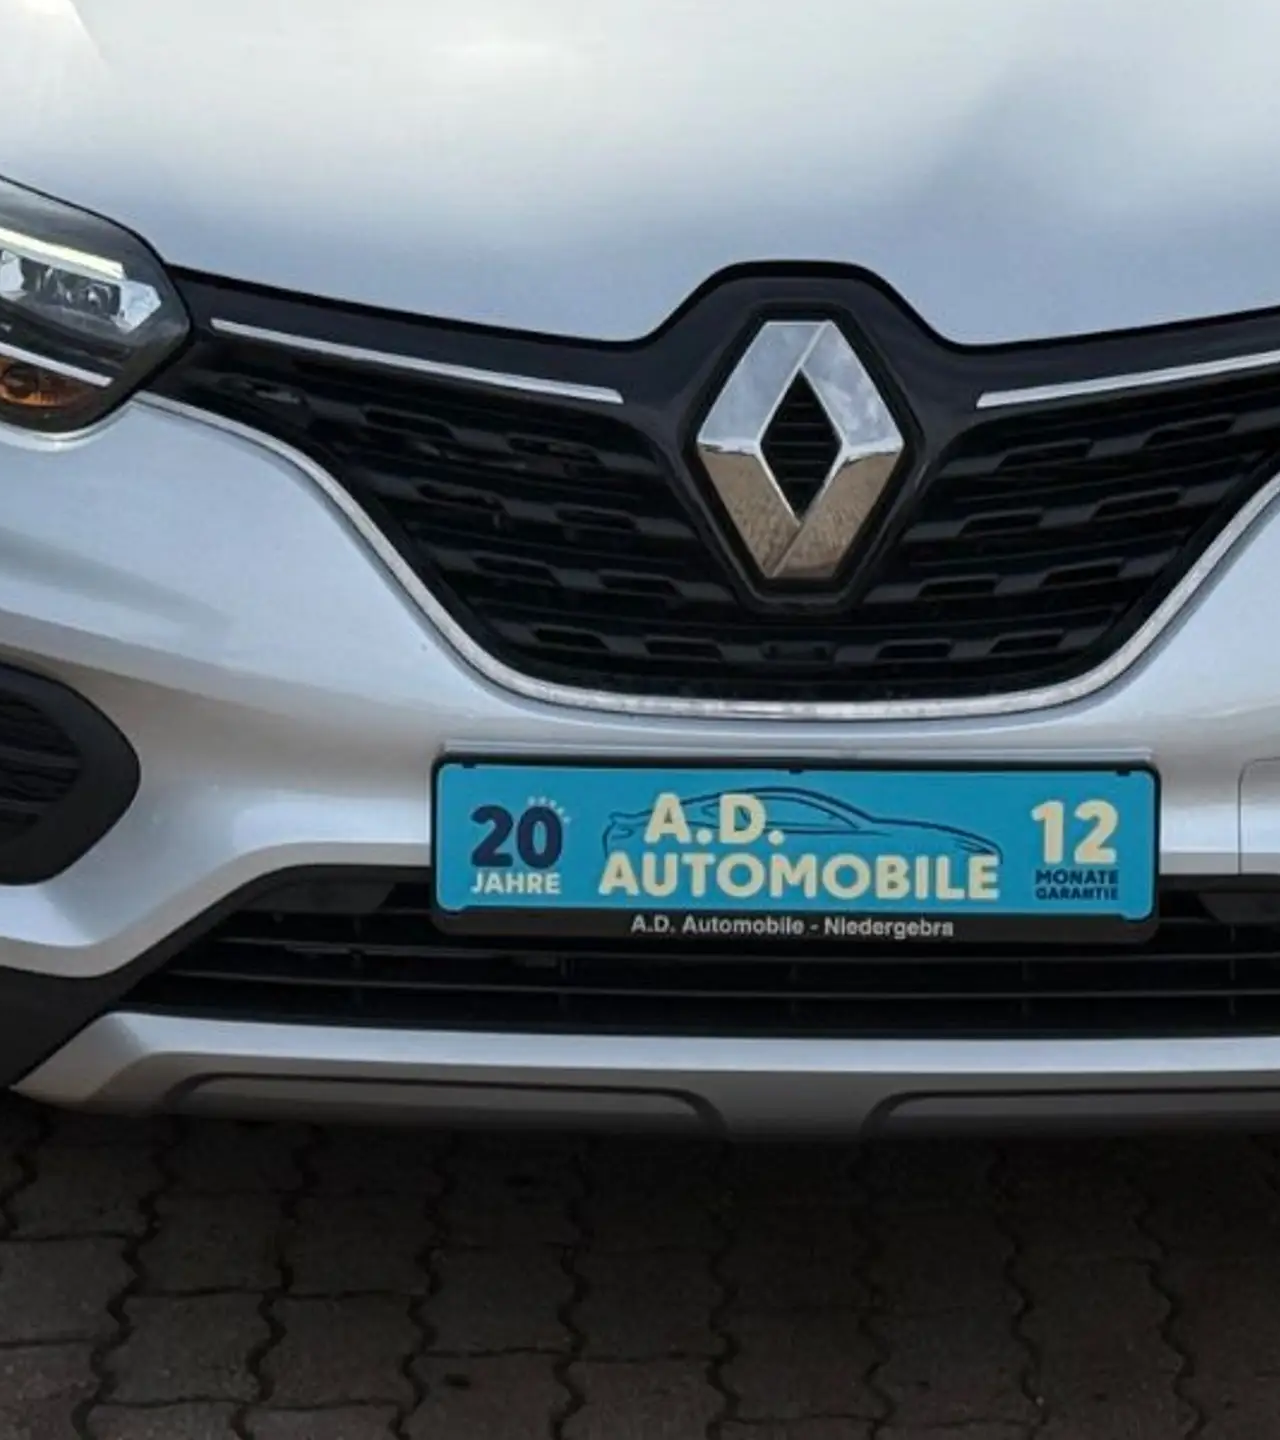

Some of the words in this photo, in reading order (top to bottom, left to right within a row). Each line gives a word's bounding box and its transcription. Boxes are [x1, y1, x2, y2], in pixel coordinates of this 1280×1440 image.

[470, 804, 563, 869] 20
[643, 792, 786, 845] A.D.
[1031, 799, 1119, 864] 12
[470, 872, 562, 895] JAHRE
[597, 852, 1000, 900] AUTOMOBILE
[1034, 869, 1119, 885] MONATE
[1034, 887, 1119, 901] GARANTIE
[630, 914, 675, 935] A.D.
[682, 915, 805, 936] Automobile
[823, 917, 955, 940] Niedergebra
